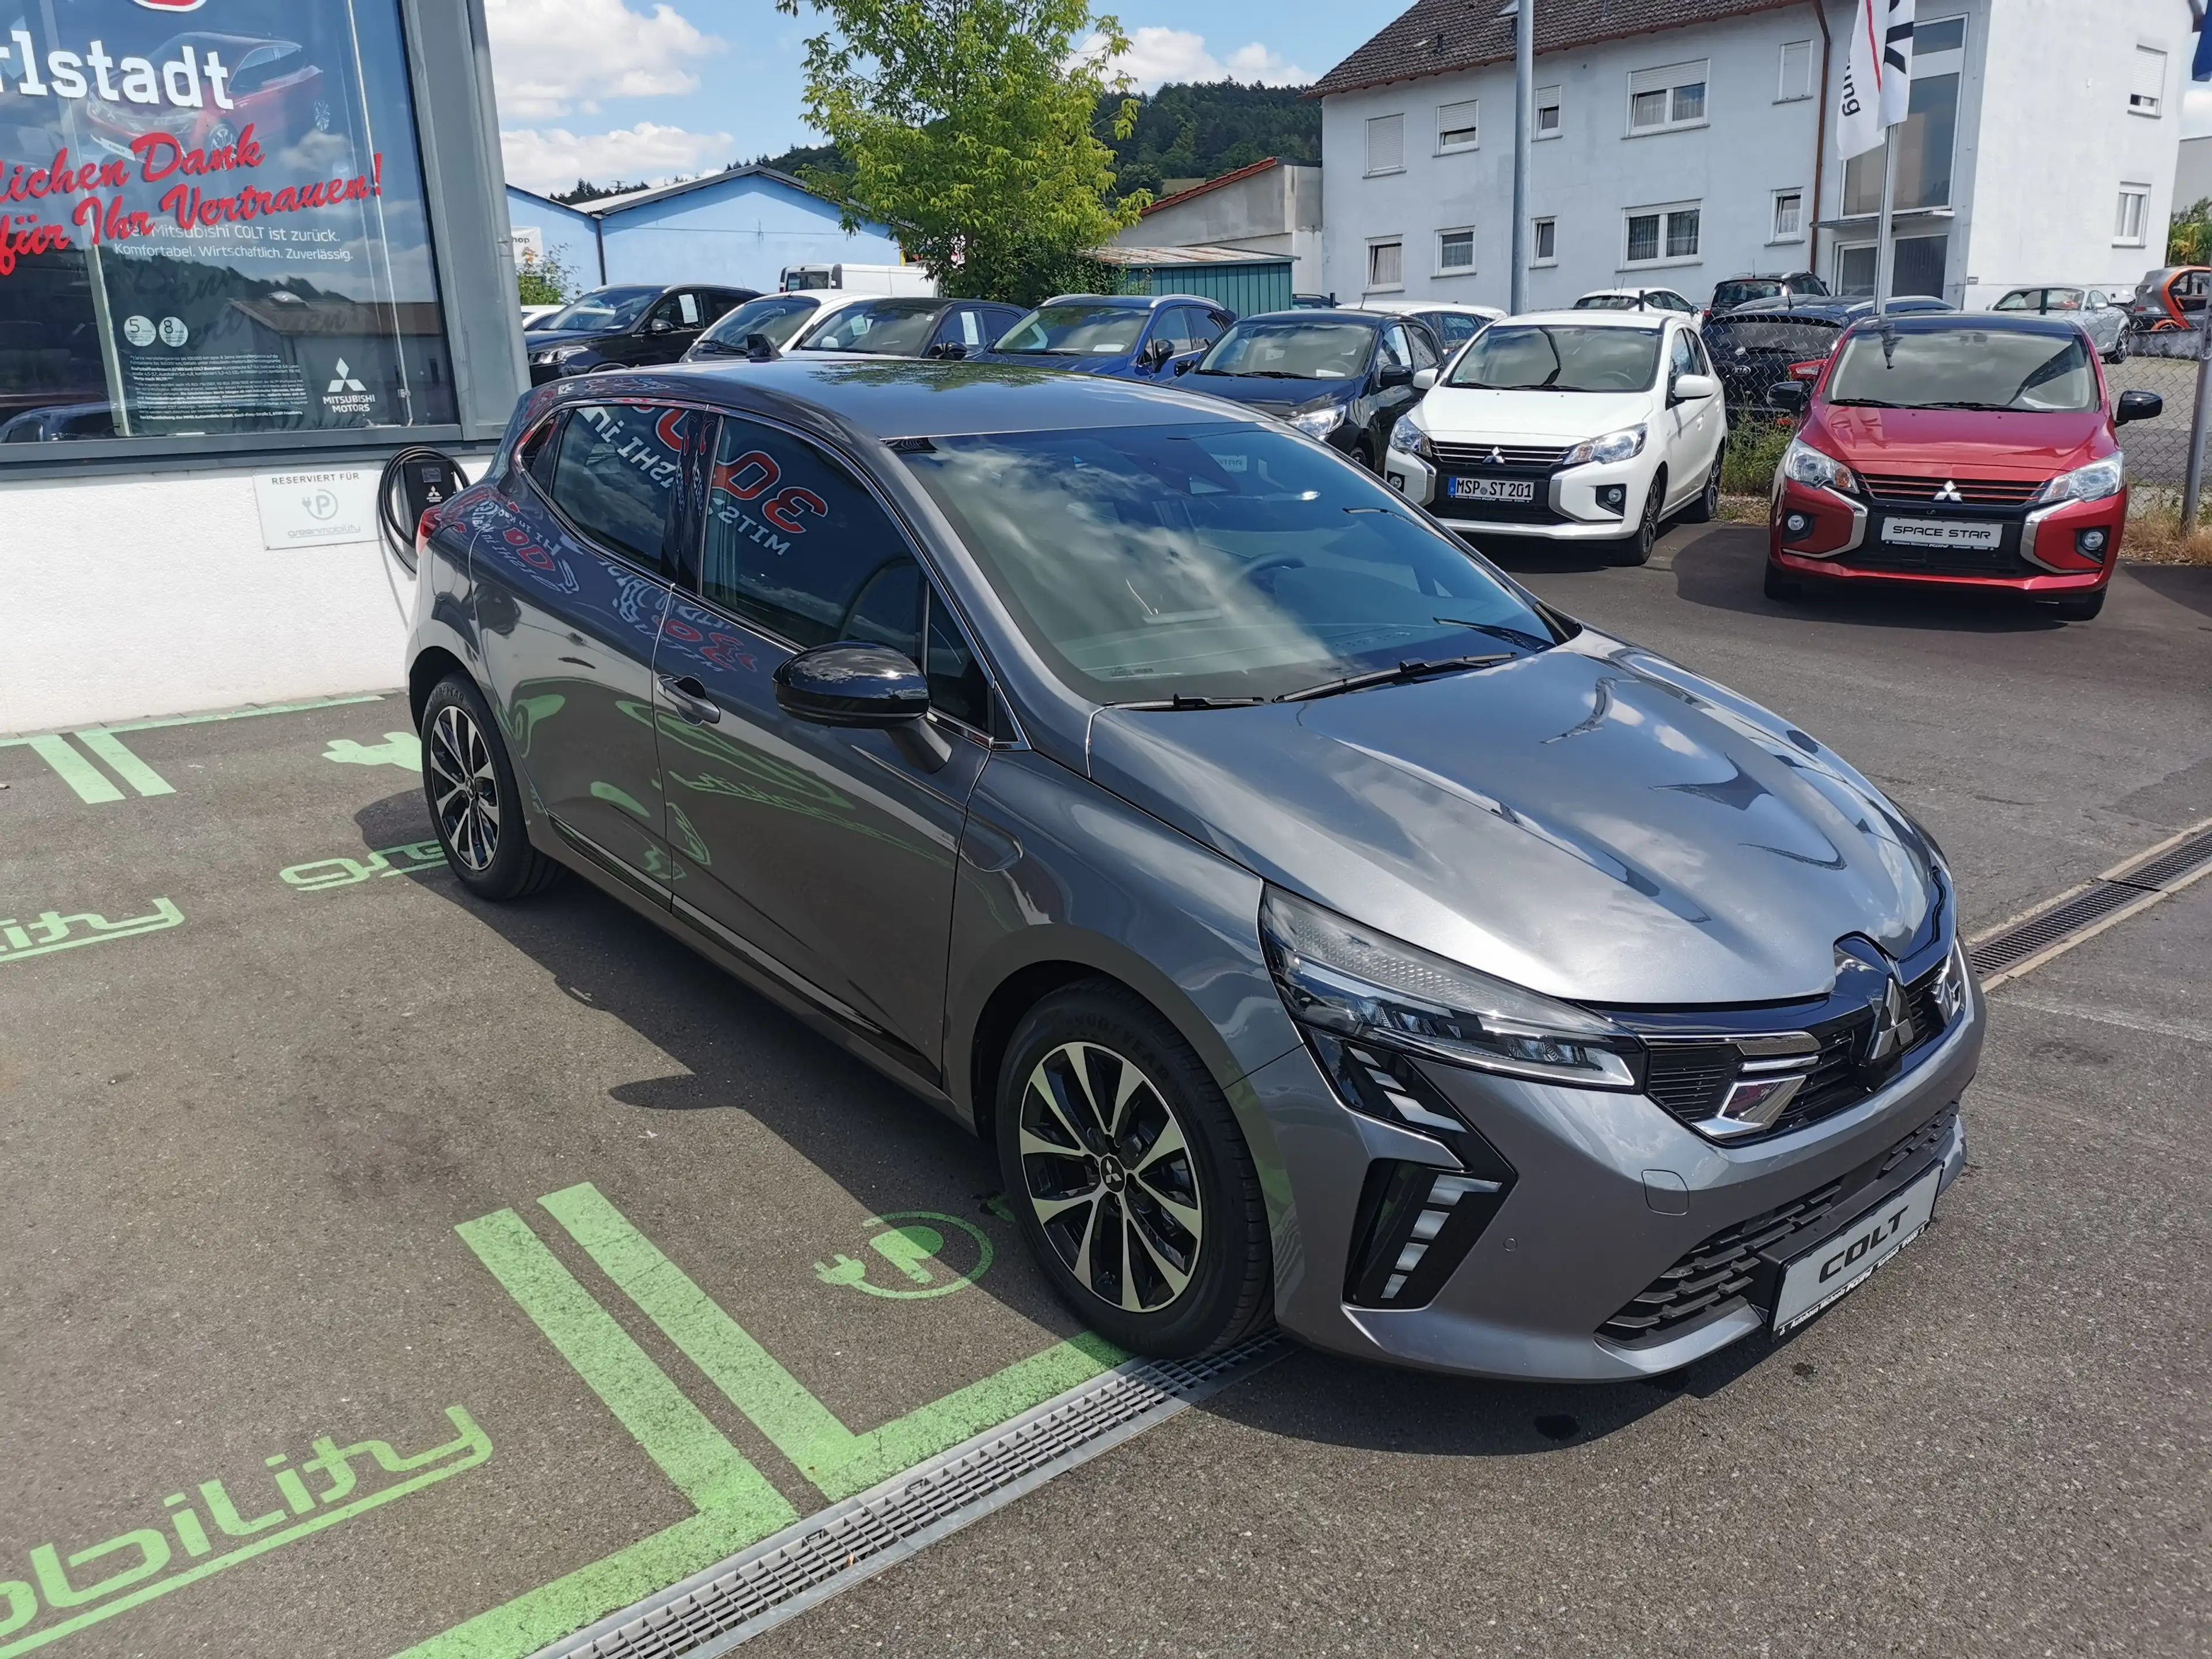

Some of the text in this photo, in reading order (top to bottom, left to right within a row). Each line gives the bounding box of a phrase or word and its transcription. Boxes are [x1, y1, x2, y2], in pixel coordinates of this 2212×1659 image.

[131, 123, 265, 183] Dank
[0, 152, 382, 275] für Ihr Vertrauen!
[151, 224, 230, 238] Mitsubishi
[234, 225, 264, 239] COLT
[268, 227, 287, 240] ist
[290, 229, 340, 242] zurück.
[114, 243, 354, 262] Komfortabel. Wirtschaftlich. Zuverlässig.
[129, 319, 140, 333] 5
[164, 320, 173, 334] 8
[323, 395, 376, 404] MITSUBISHI
[332, 404, 370, 413] MOTORS
[271, 472, 359, 485] RESERVIERT FÜR
[1456, 480, 1532, 498] MSP ST 201
[1892, 525, 1991, 539] SPACE STAR
[1818, 1205, 1909, 1283] COLT
